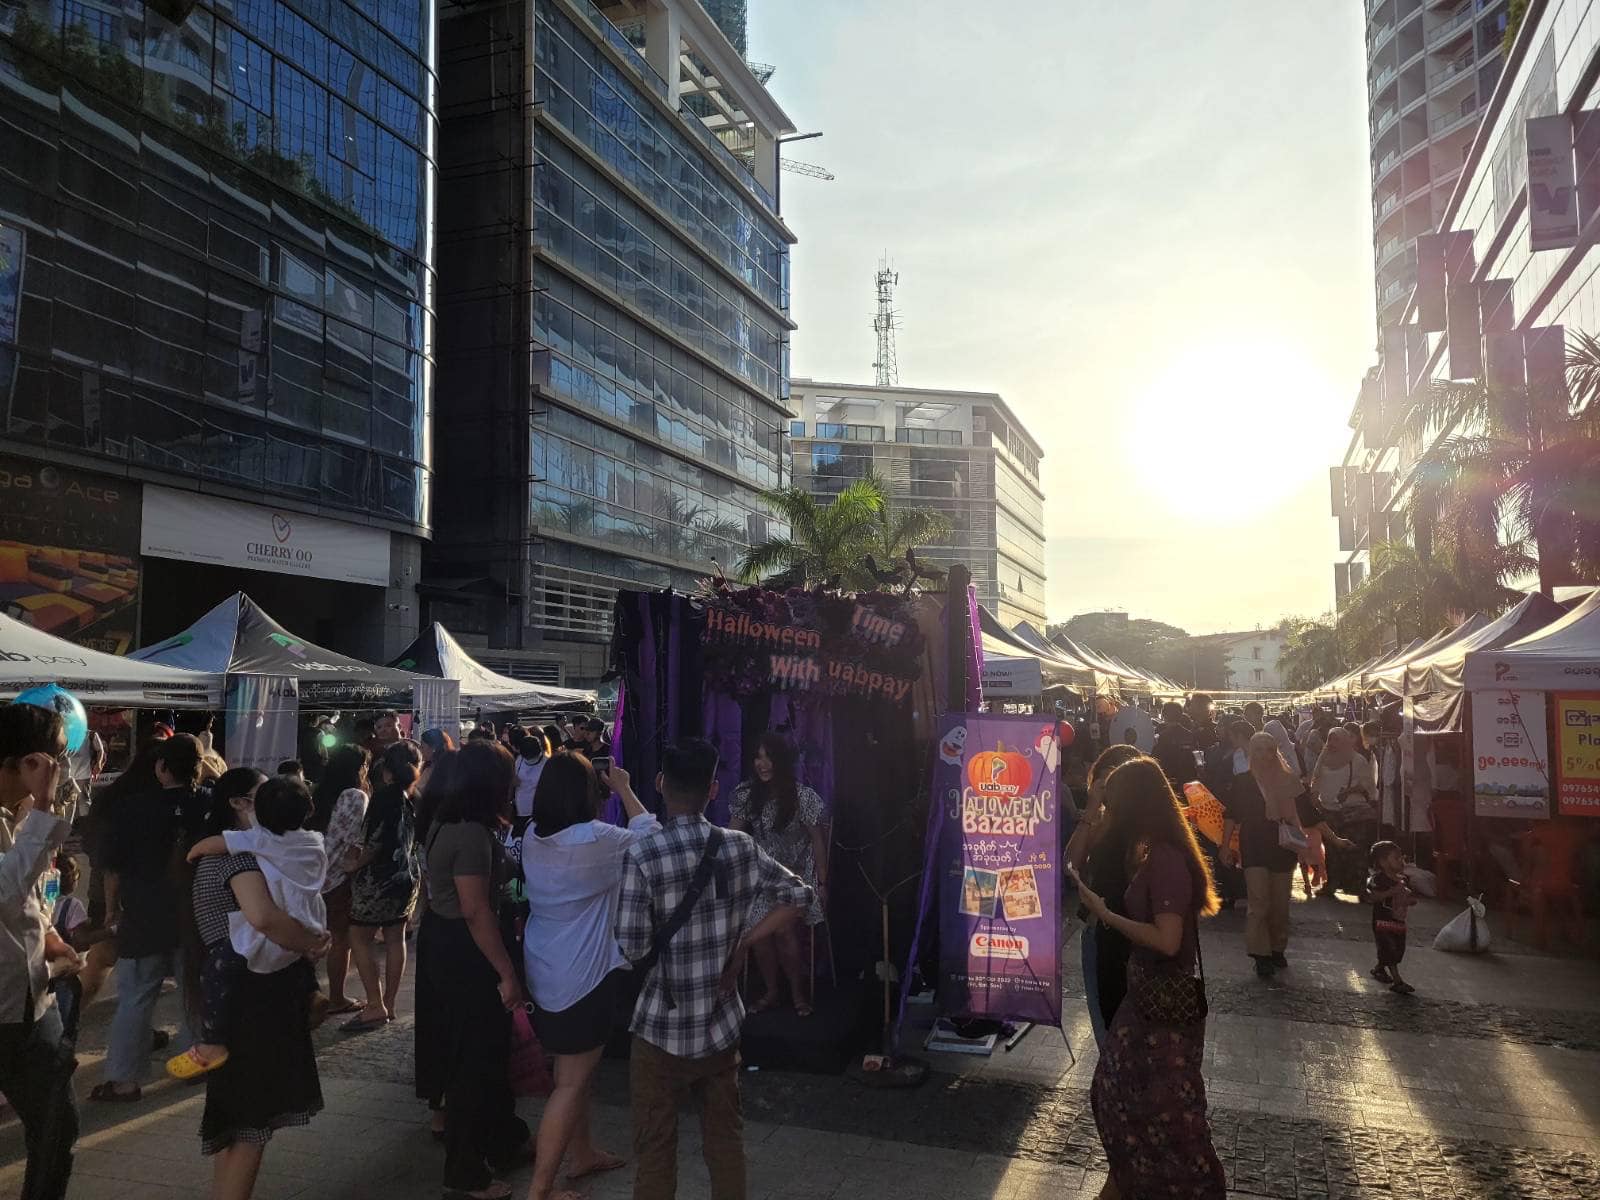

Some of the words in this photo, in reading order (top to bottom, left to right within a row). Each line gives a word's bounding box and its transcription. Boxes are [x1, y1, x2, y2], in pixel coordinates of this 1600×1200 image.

[64, 480, 120, 504] Ace
[246, 542, 291, 560] CHERRY
[295, 549, 313, 562] OO
[706, 607, 820, 648] Halloween
[852, 603, 906, 641] Time
[142, 681, 185, 691] DOWNLOAD
[769, 653, 821, 683] With
[827, 660, 912, 700] uabpay
[962, 811, 1040, 836] Bazaar
[975, 936, 1024, 950] Canon
